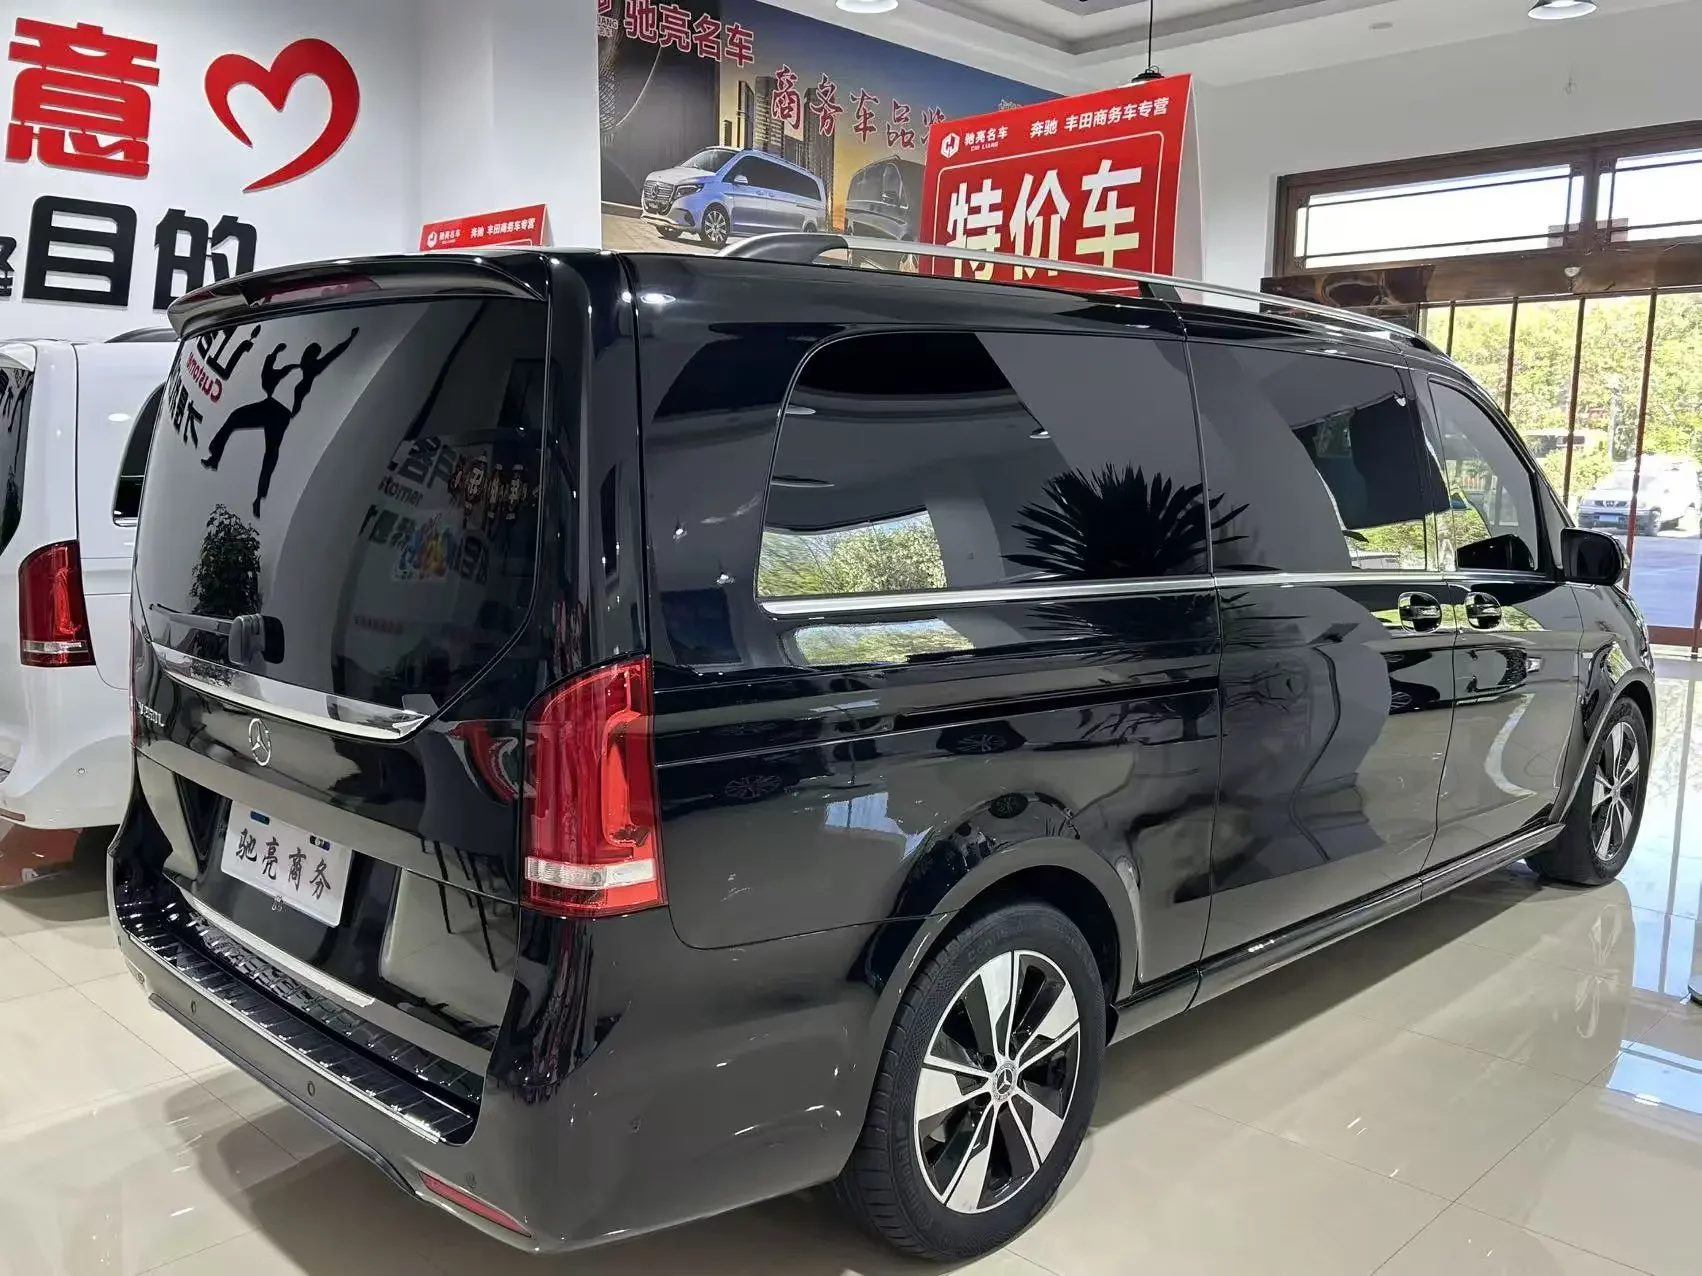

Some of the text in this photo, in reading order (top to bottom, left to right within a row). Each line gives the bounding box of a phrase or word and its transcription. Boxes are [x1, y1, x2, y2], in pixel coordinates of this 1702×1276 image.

[624, 0, 755, 68] 驰亮名车
[5, 17, 160, 180] 意
[964, 97, 1170, 146] 驰亮名车 奔驰 丰田商务车专营
[946, 159, 1143, 281] 特价车
[235, 828, 332, 900] 驰亮商务
